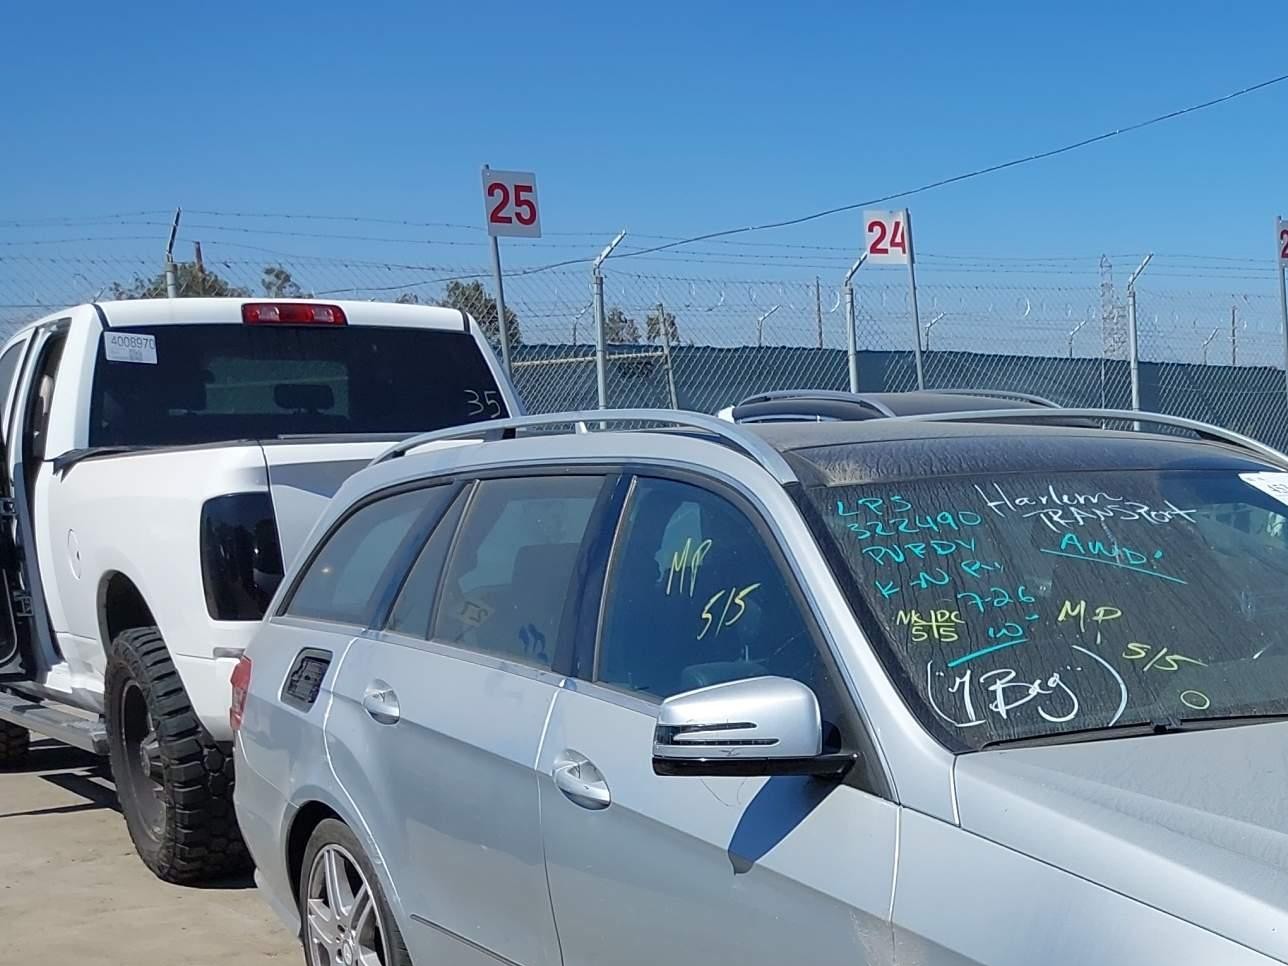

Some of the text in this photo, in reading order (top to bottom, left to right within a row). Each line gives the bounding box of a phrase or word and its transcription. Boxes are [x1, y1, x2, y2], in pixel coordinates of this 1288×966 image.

[487, 182, 537, 226] 25
[867, 220, 907, 255] 24
[463, 389, 501, 419] 35
[973, 482, 1123, 518] Harlem
[847, 511, 982, 539] 322490
[665, 537, 713, 598] MP
[696, 583, 762, 640] 5/5
